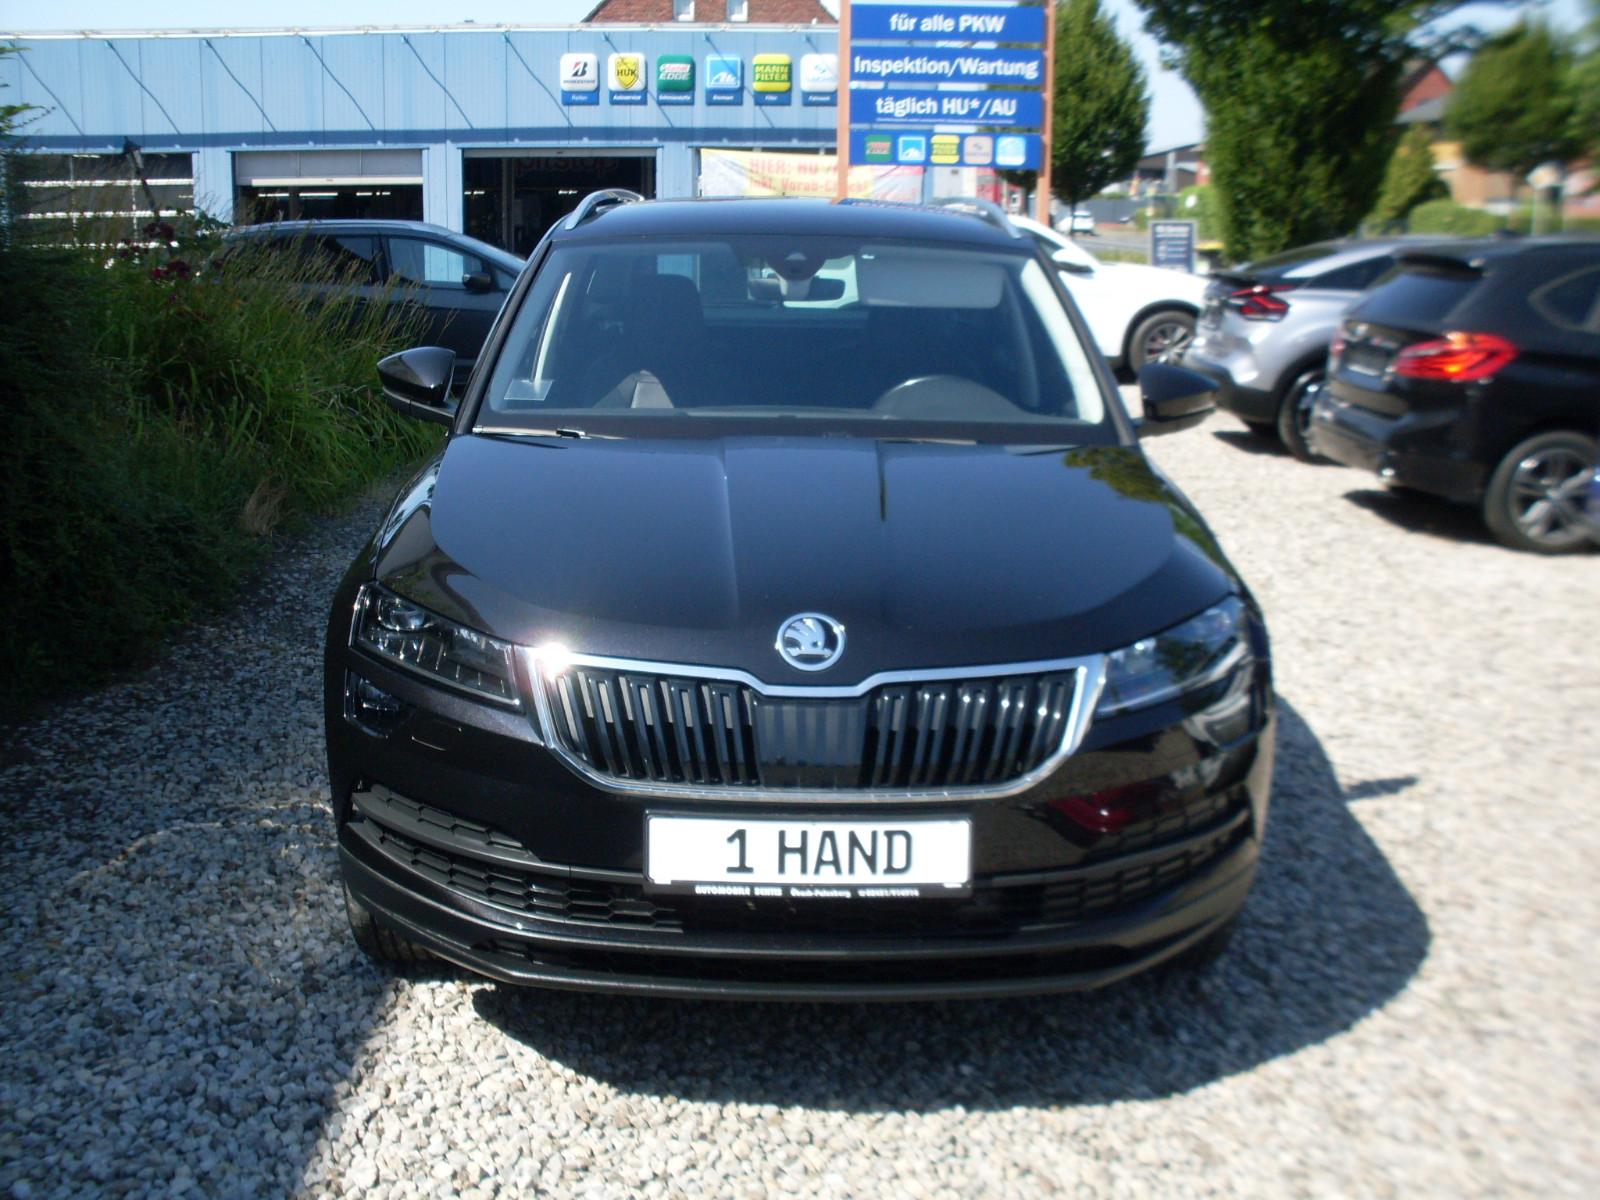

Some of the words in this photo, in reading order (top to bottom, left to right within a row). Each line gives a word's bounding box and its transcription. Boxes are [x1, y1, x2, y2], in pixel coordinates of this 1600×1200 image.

[890, 13, 916, 32] für
[920, 14, 954, 33] alle
[959, 15, 1006, 33] PKW
[659, 72, 690, 80] EDGE
[755, 65, 789, 73] MANN
[755, 73, 788, 81] FILTER
[854, 56, 1039, 80] Inspektion/Wartung
[876, 97, 937, 117] täglich
[726, 828, 754, 874] 1
[778, 830, 913, 875] HAND
